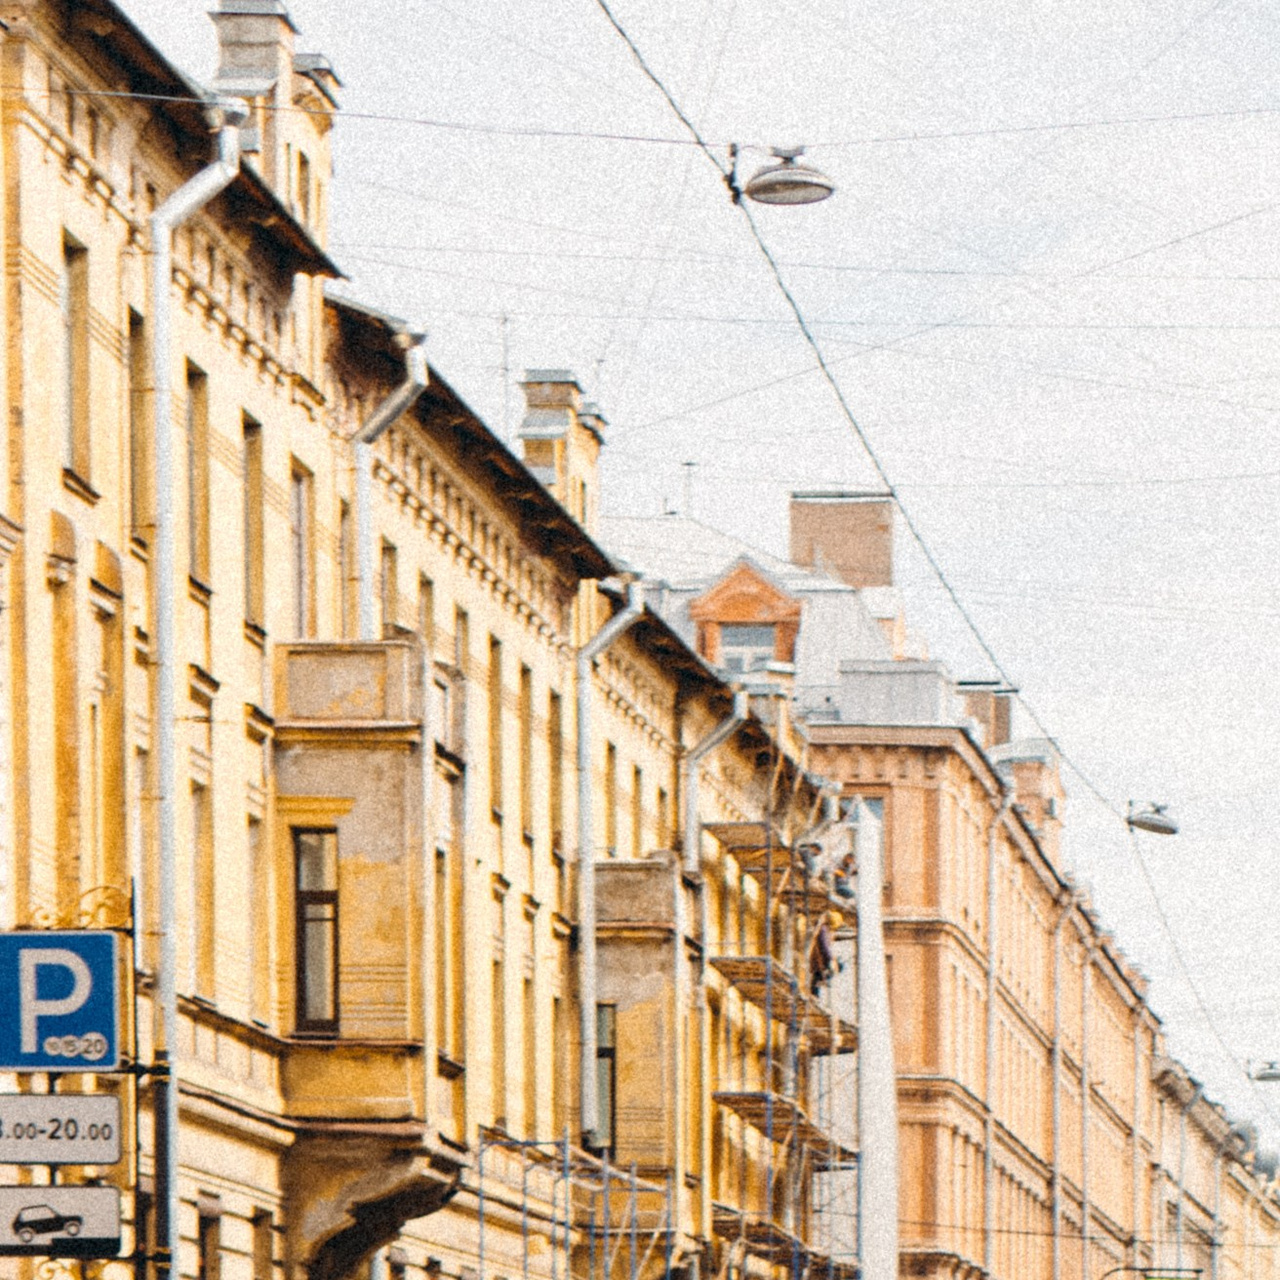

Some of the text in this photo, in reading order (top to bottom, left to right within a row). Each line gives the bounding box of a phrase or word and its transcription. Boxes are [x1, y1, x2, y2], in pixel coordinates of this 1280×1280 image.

[19, 948, 93, 1054] P
[82, 1038, 104, 1054] 20
[0, 1118, 113, 1140] .00-20.00
